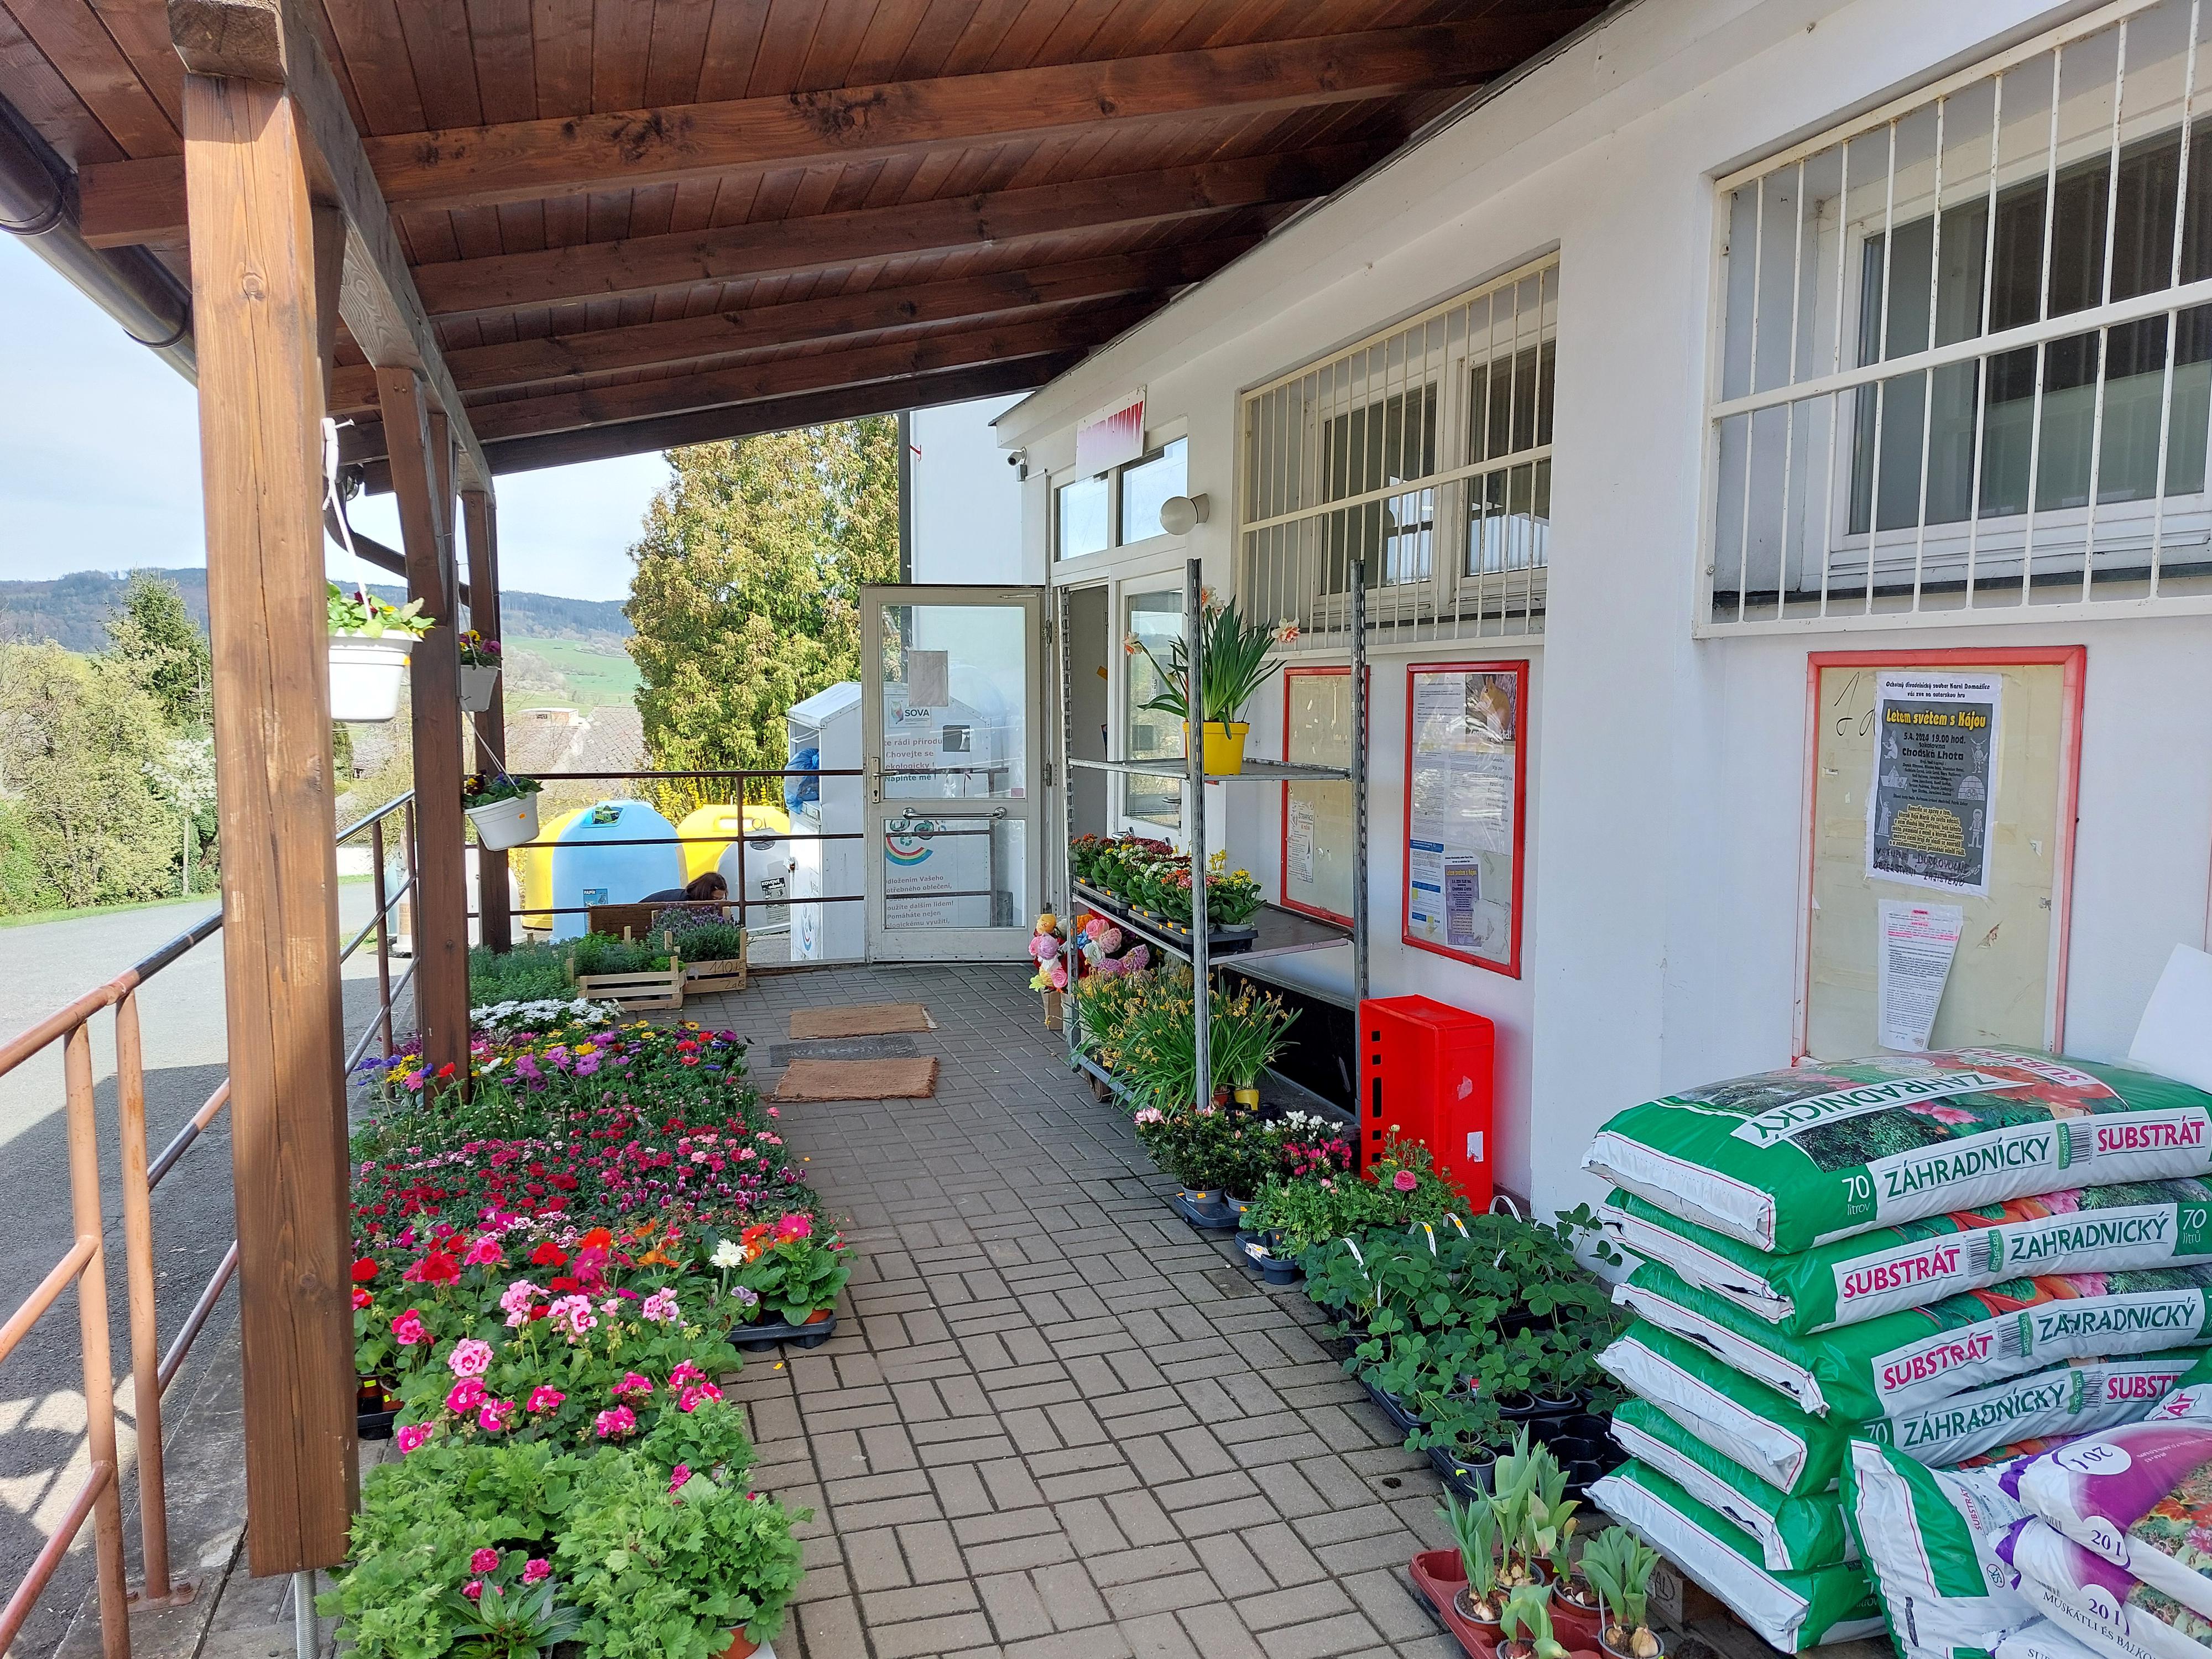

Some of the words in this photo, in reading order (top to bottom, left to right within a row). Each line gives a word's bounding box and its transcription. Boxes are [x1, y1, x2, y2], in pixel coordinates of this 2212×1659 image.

[1886, 708, 1911, 724] Letem
[1913, 709, 1947, 726] světem
[1949, 714, 1955, 726] s
[1958, 709, 1987, 731] Kájou
[913, 737, 942, 747] přírodu
[1916, 733, 1929, 742] 2024
[1932, 734, 1949, 743] 19.00
[1950, 734, 1966, 744] hod.
[1902, 748, 1936, 758] Chodská
[1937, 749, 1964, 761] Lhota
[926, 917, 950, 926] využití,
[709, 961, 733, 973] 110
[1750, 1073, 1997, 1140] ZAHRADNICKÝ
[2098, 1115, 2205, 1152] SUBSTRÁT
[1884, 1136, 2051, 1198] ZÁHRADNÍCKY
[1841, 1175, 1870, 1202] 70
[1847, 1202, 1871, 1216] litrov
[2183, 1208, 2206, 1230] 70
[2010, 1211, 2169, 1261] ZAHRADNICKÝ
[2182, 1230, 2200, 1245] litrů
[1991, 1233, 2001, 1270] Forestina
[1843, 1244, 1960, 1298] SUBSTRÁT
[2038, 1296, 2195, 1342] ZAHRADNICKÝ
[1884, 1332, 1994, 1390] SUBSTRÁT
[2071, 1374, 2082, 1412] Foreina
[2107, 1375, 2180, 1400] SUBST
[1903, 1387, 2065, 1447] ZÁHRADNÍCKY
[2083, 1446, 2114, 1462] 20
[1960, 1488, 1982, 1531] SUBSTRÁT
[2090, 1530, 2111, 1550] 20
[1988, 1567, 2002, 1584] SK
[2088, 1598, 2109, 1620] 20
[2043, 1592, 2098, 1631] MUSKÁTLI
[2101, 1626, 2115, 1640] ÉS
[2116, 1635, 2157, 1659] BALKO
